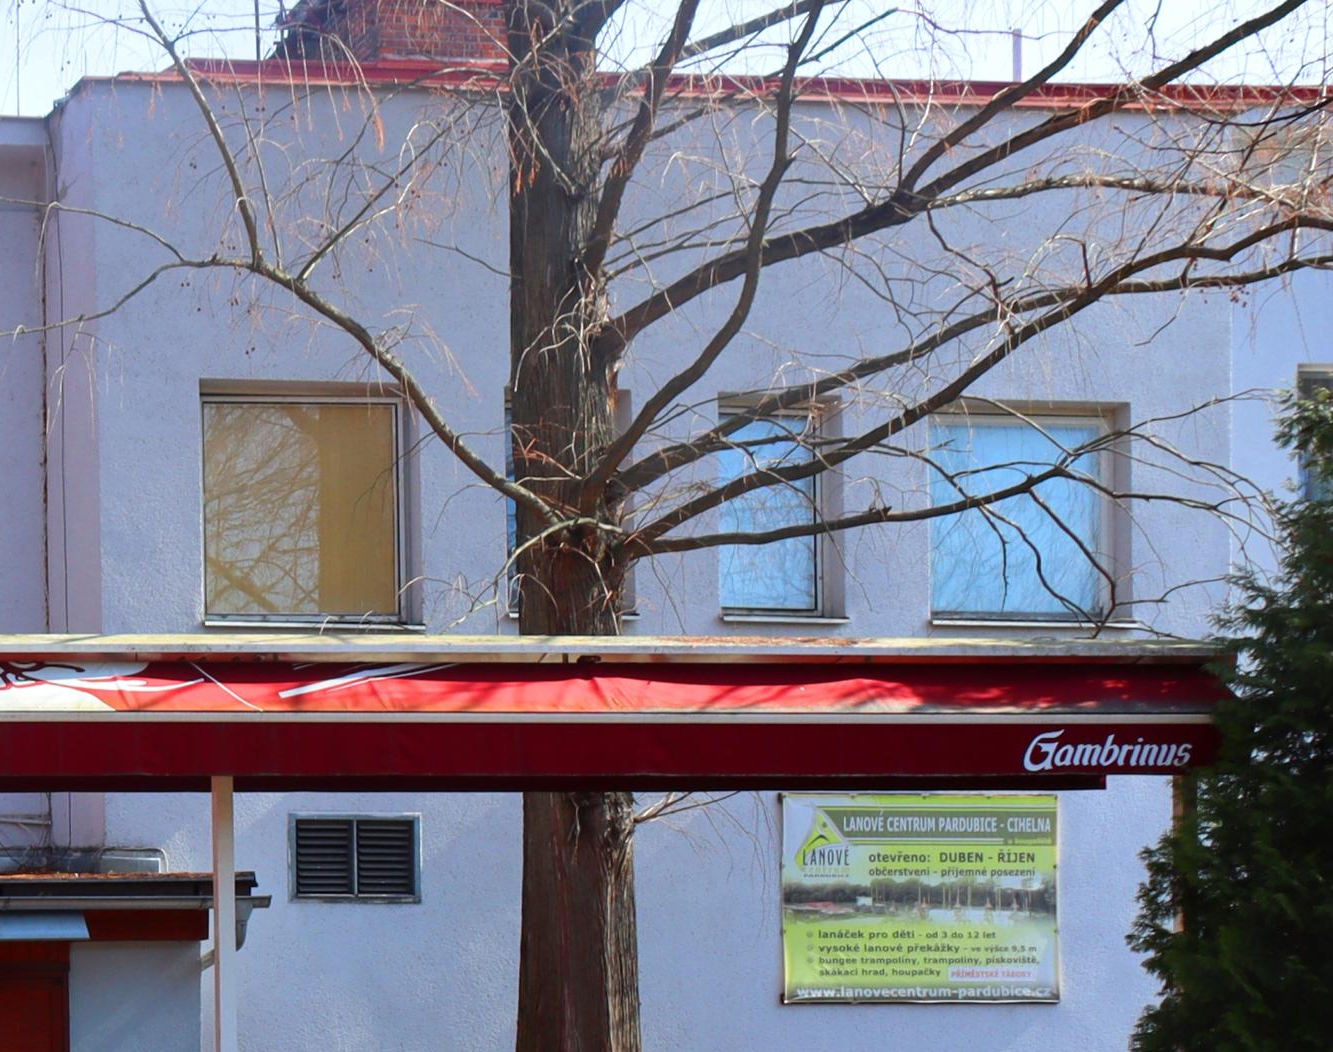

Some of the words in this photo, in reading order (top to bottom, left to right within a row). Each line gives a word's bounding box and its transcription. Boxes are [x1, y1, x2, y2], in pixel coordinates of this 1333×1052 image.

[1023, 729, 1192, 772] Gambrinus
[843, 812, 884, 832] LANOVÉ
[887, 816, 935, 833] CENTRUM
[938, 816, 997, 833] PARDUBICE
[1007, 816, 1051, 833] CIHELNA
[803, 847, 850, 866] LANOVÉ
[868, 851, 931, 863] otevřeno:
[939, 852, 983, 863] DUBEN
[997, 849, 1035, 863] ŘÍJEN
[941, 867, 987, 878] příjemné
[990, 867, 1035, 878] posezení
[818, 930, 864, 939] lanáček
[869, 931, 888, 940] pro
[892, 930, 915, 939] děti
[951, 931, 964, 939] do
[968, 931, 980, 939] 12
[819, 944, 860, 954] vysoké
[864, 944, 903, 952] lanové
[907, 943, 960, 954] překážky
[819, 956, 857, 966] bungee
[891, 968, 941, 977] houpačky
[796, 985, 1051, 999] www.lanovecentrum-pardubice.cz
